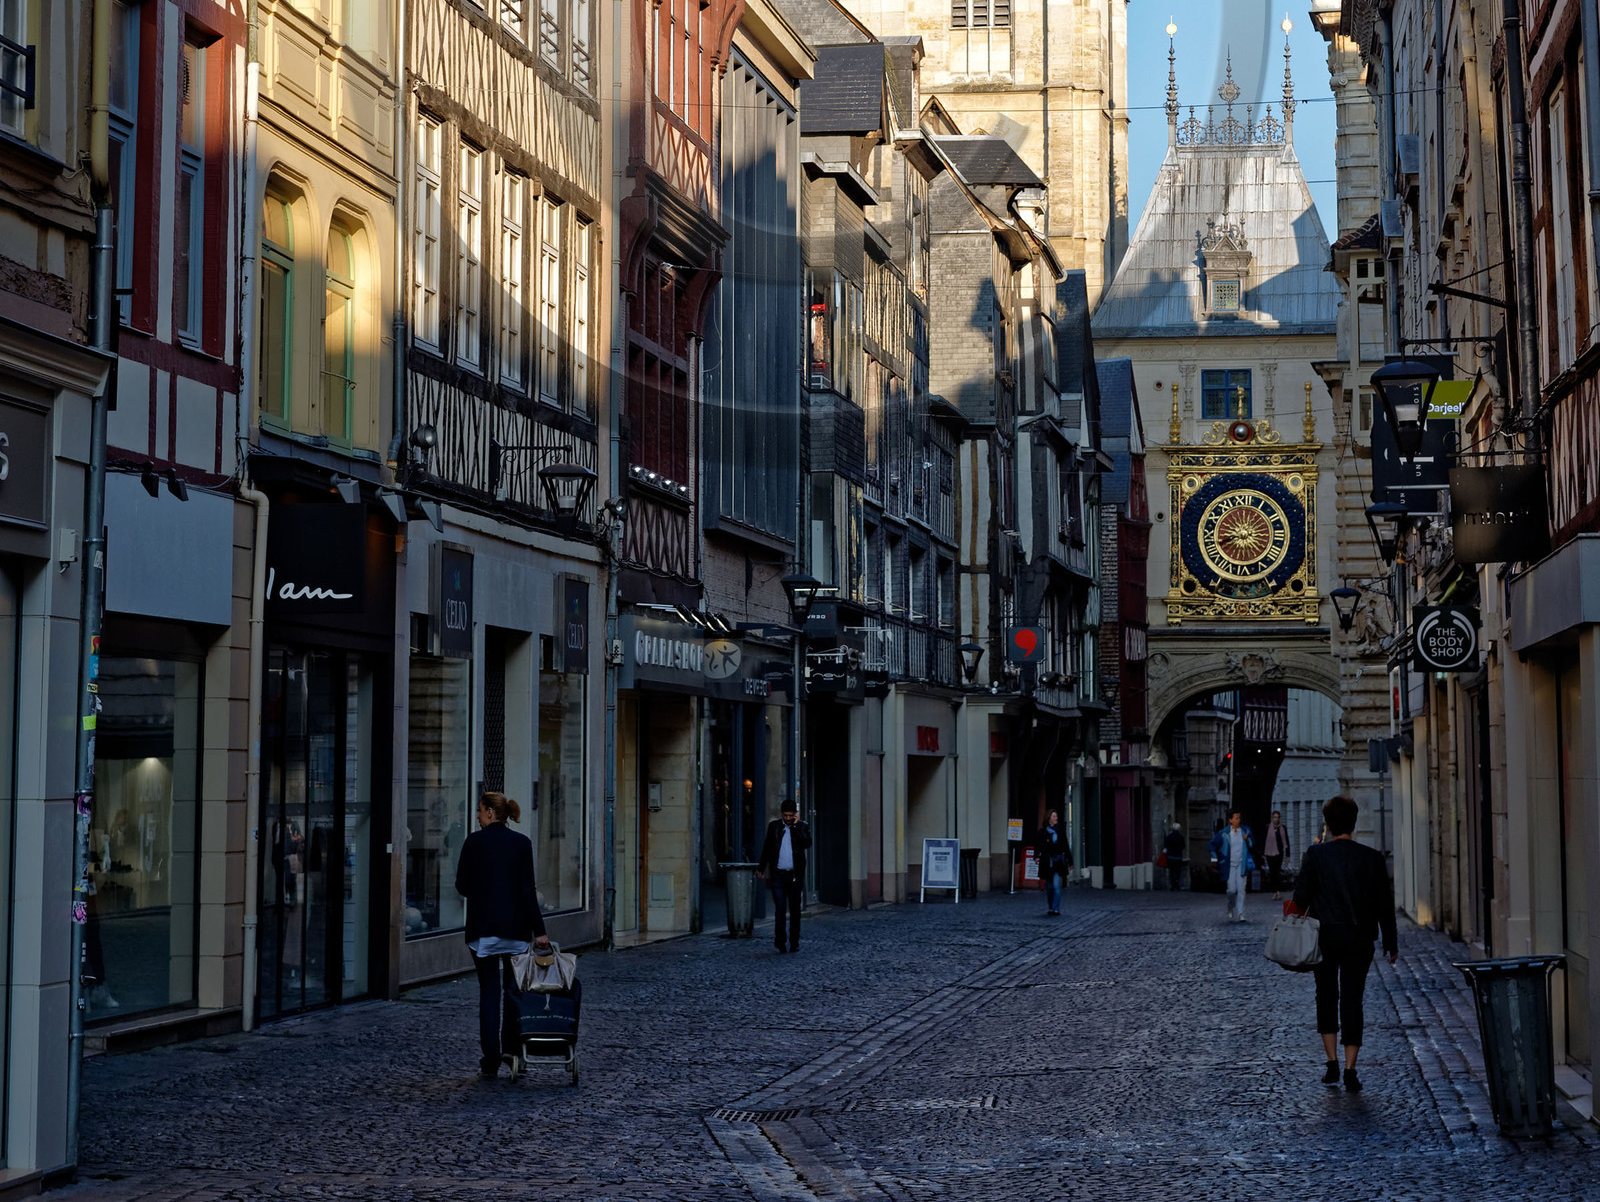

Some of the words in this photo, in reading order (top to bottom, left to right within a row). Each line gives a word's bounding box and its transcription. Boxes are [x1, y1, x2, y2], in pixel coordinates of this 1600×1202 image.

[445, 598, 468, 631] CELIO
[1435, 627, 1457, 636] THE
[1428, 636, 1465, 647] BODY
[1430, 647, 1463, 657] SHOP
